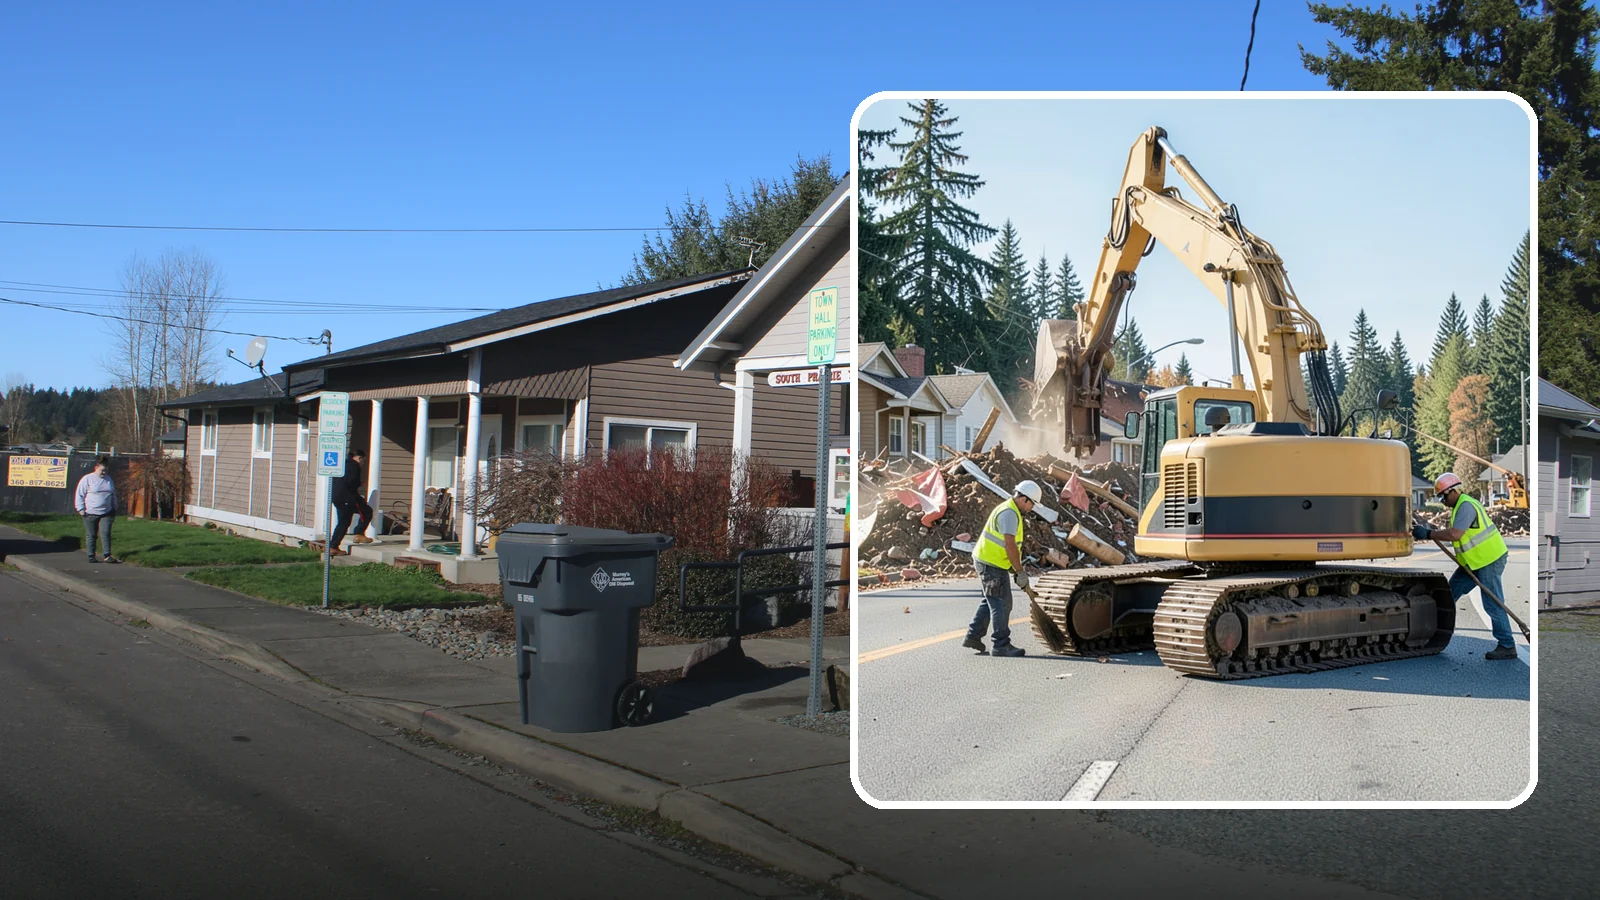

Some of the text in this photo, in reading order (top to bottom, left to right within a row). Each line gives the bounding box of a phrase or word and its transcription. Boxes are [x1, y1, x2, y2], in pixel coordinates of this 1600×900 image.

[815, 294, 833, 308] TOWN
[815, 312, 831, 324] HALL
[810, 326, 836, 340] PARKING
[814, 344, 831, 357] ONLY
[775, 373, 801, 384] SOUTH
